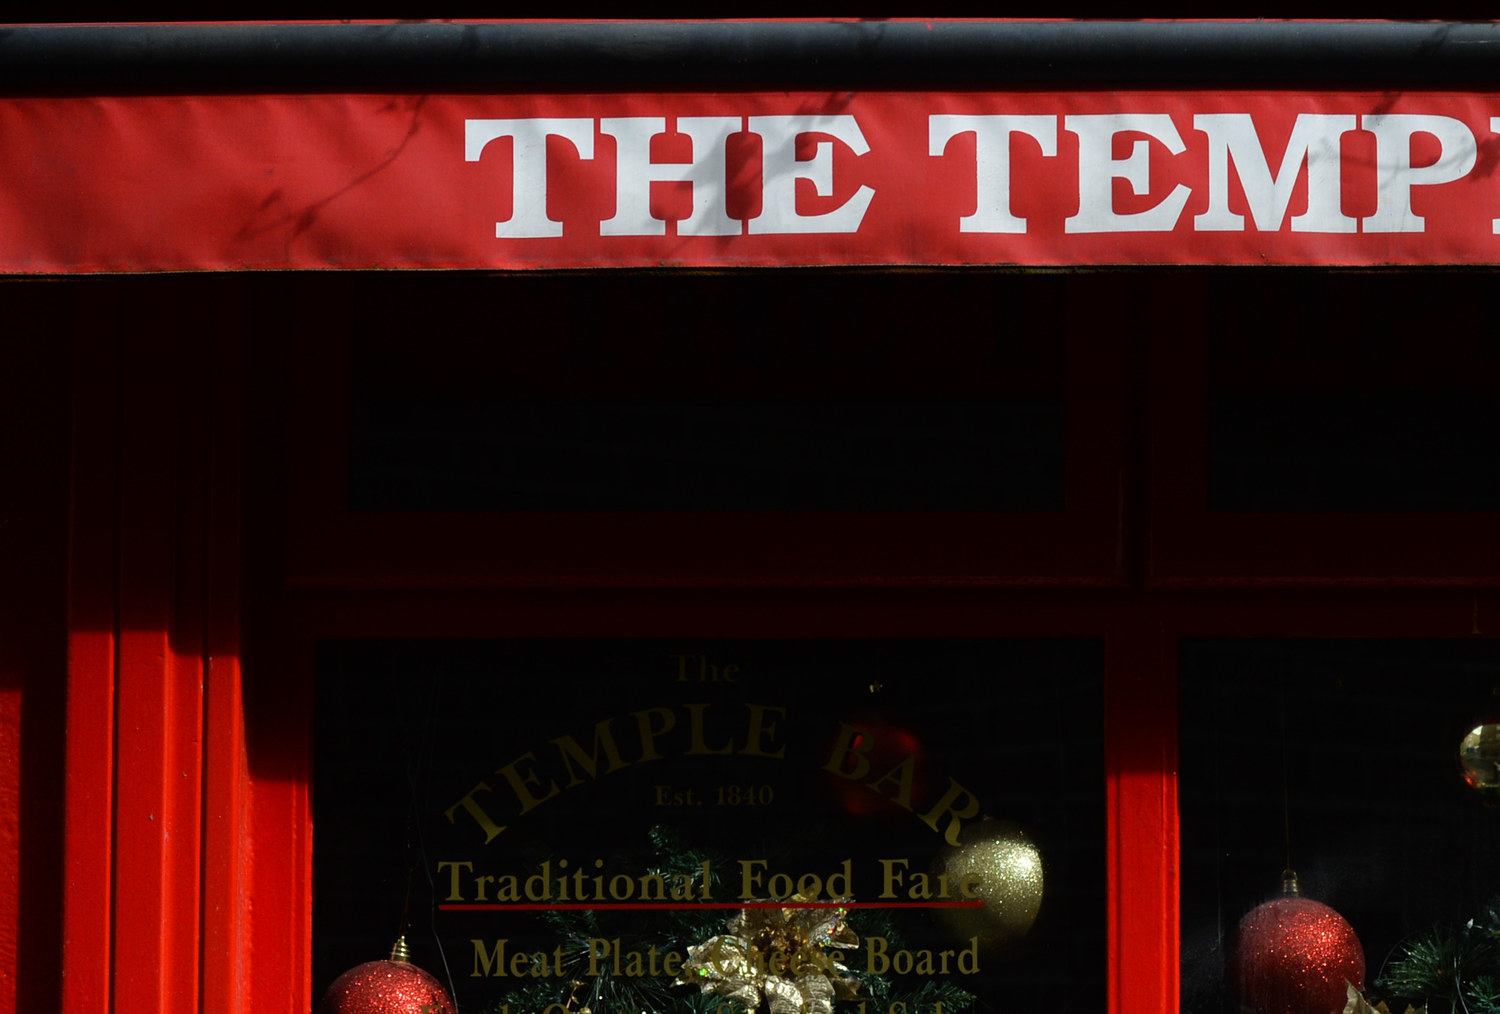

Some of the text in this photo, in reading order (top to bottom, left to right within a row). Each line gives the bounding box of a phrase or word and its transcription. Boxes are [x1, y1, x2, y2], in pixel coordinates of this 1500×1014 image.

[465, 115, 875, 239] THE
[668, 654, 740, 684] The
[445, 703, 980, 846] TEMPLE BAR
[655, 784, 774, 808] Est. 1840
[437, 858, 983, 903] Traditional Food Fare
[469, 938, 565, 978] Meat
[585, 938, 692, 984] Plate,
[864, 936, 982, 978] Board
